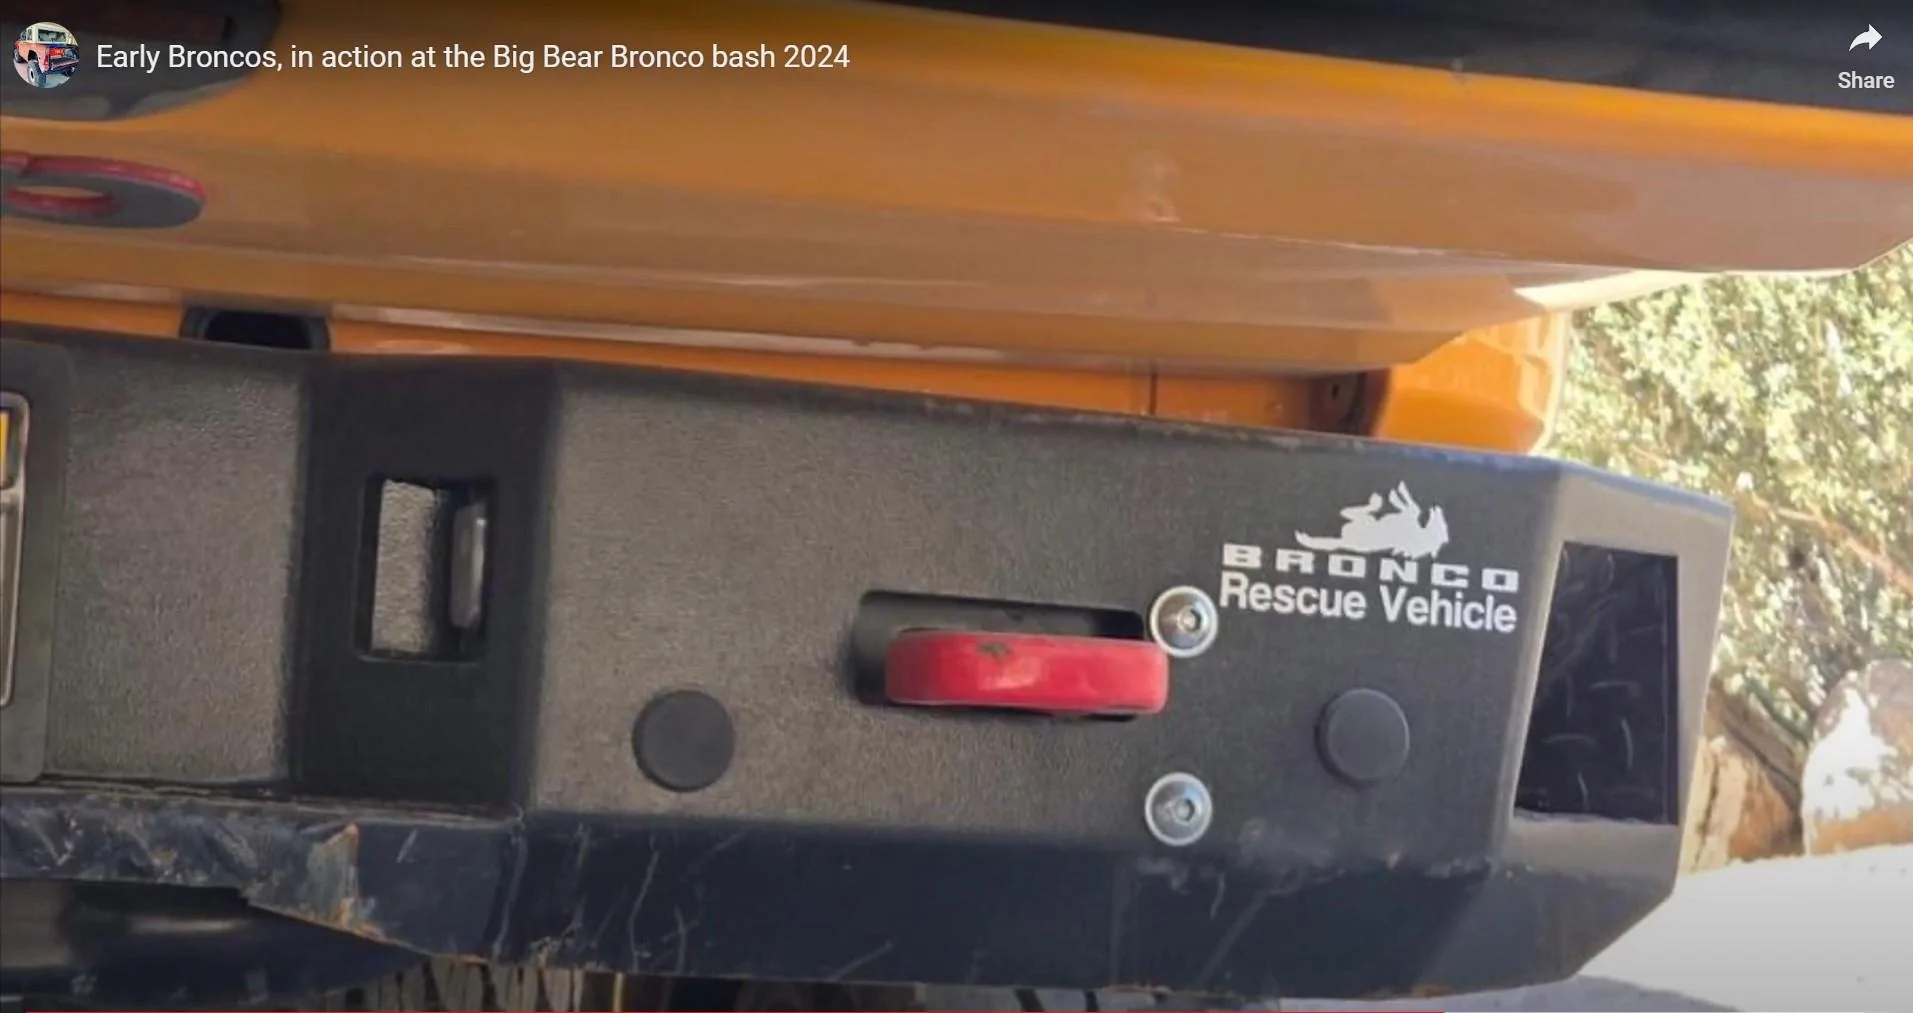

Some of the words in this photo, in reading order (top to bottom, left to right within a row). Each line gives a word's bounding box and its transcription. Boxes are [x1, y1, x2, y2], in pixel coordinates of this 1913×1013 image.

[1222, 543, 1520, 593] BRONCO
[1219, 571, 1367, 620] Rescue
[1379, 585, 1518, 633] Vehicle
